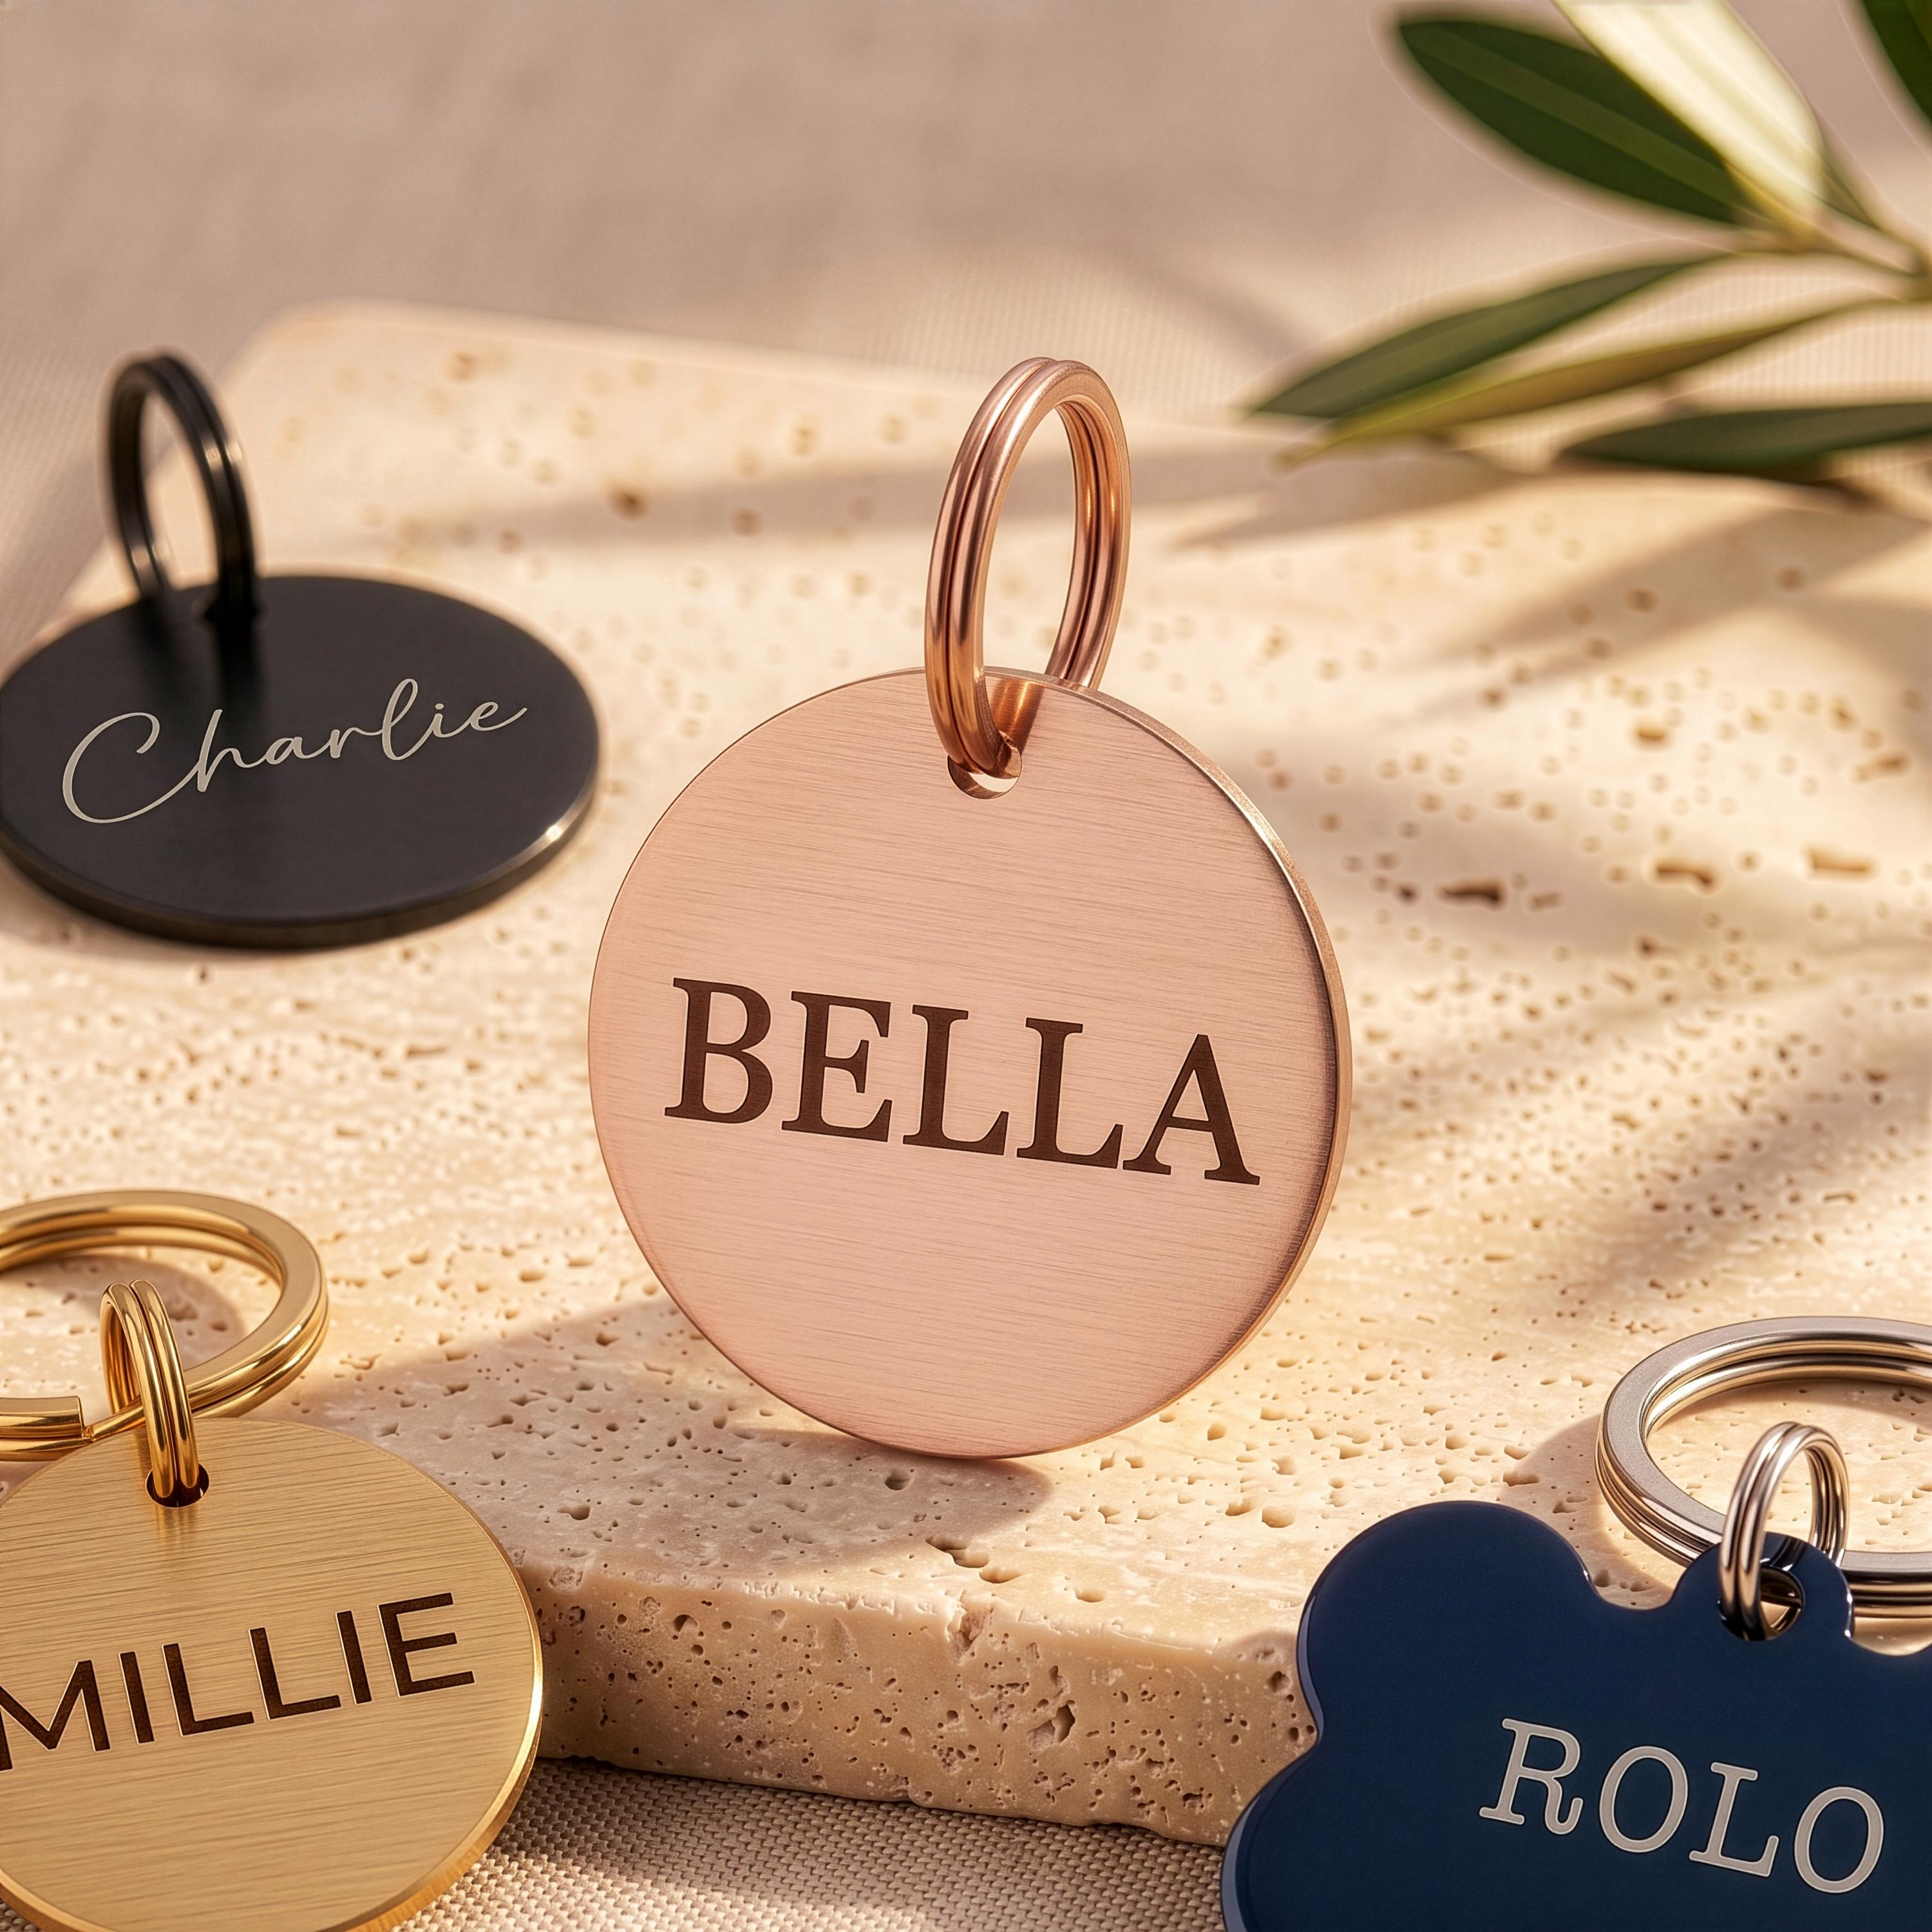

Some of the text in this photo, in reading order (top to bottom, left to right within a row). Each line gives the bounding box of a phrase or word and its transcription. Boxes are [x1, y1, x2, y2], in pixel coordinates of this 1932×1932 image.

[62, 678, 527, 824] Charlie
[665, 977, 1261, 1186] BELLA
[0, 1593, 475, 1771] MILLIE
[1479, 1718, 1884, 1893] ROLO
